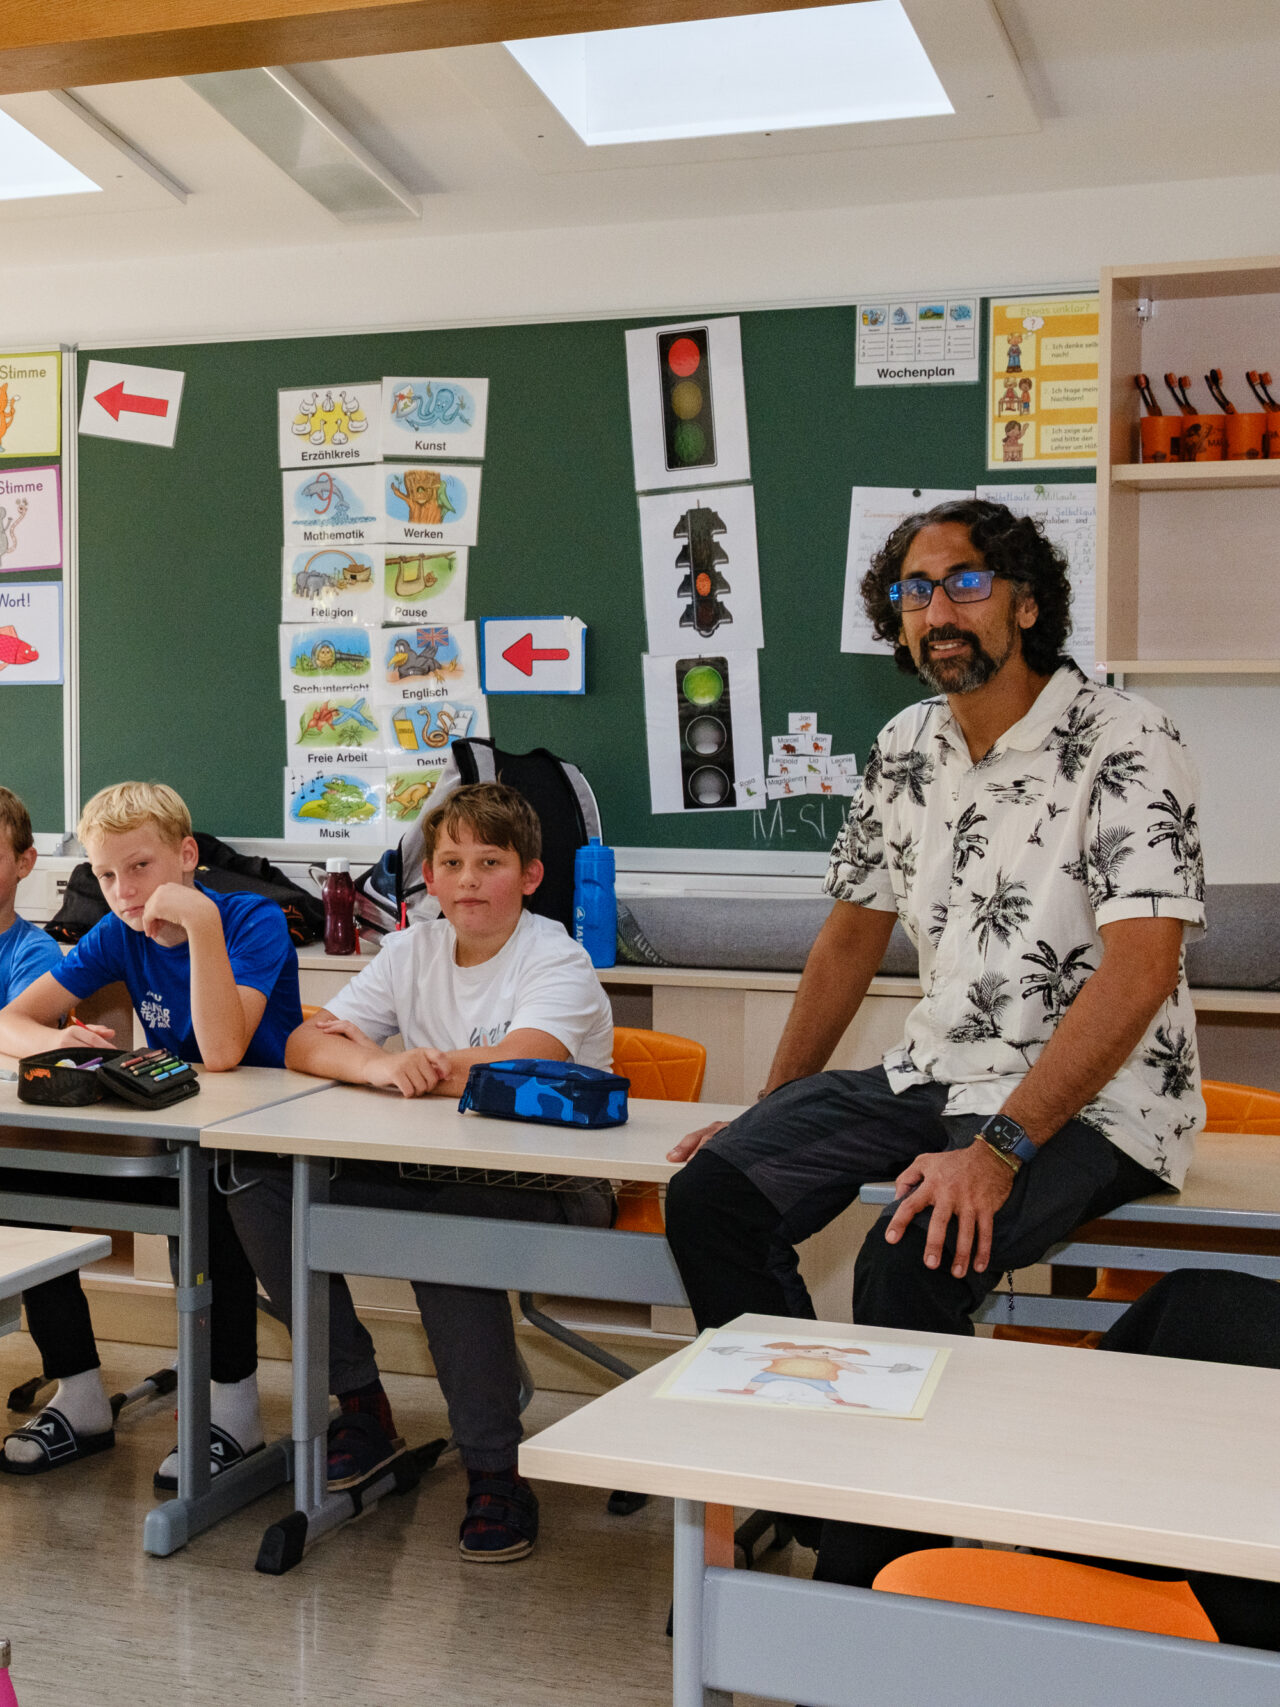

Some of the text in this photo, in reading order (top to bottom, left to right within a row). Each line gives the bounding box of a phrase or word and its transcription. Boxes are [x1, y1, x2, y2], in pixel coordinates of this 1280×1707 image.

[877, 366, 955, 379] Wochenplan
[415, 440, 446, 451] Kunst
[301, 449, 360, 462] Erzählkreis
[304, 529, 364, 541] Mathematik
[404, 528, 443, 539] Werken
[311, 607, 353, 619] Religion
[395, 606, 427, 617] Pause
[402, 687, 448, 700] Englisch
[308, 753, 368, 763] Freie Arbeit
[417, 757, 448, 766] Deuts
[320, 829, 350, 838] Musik
